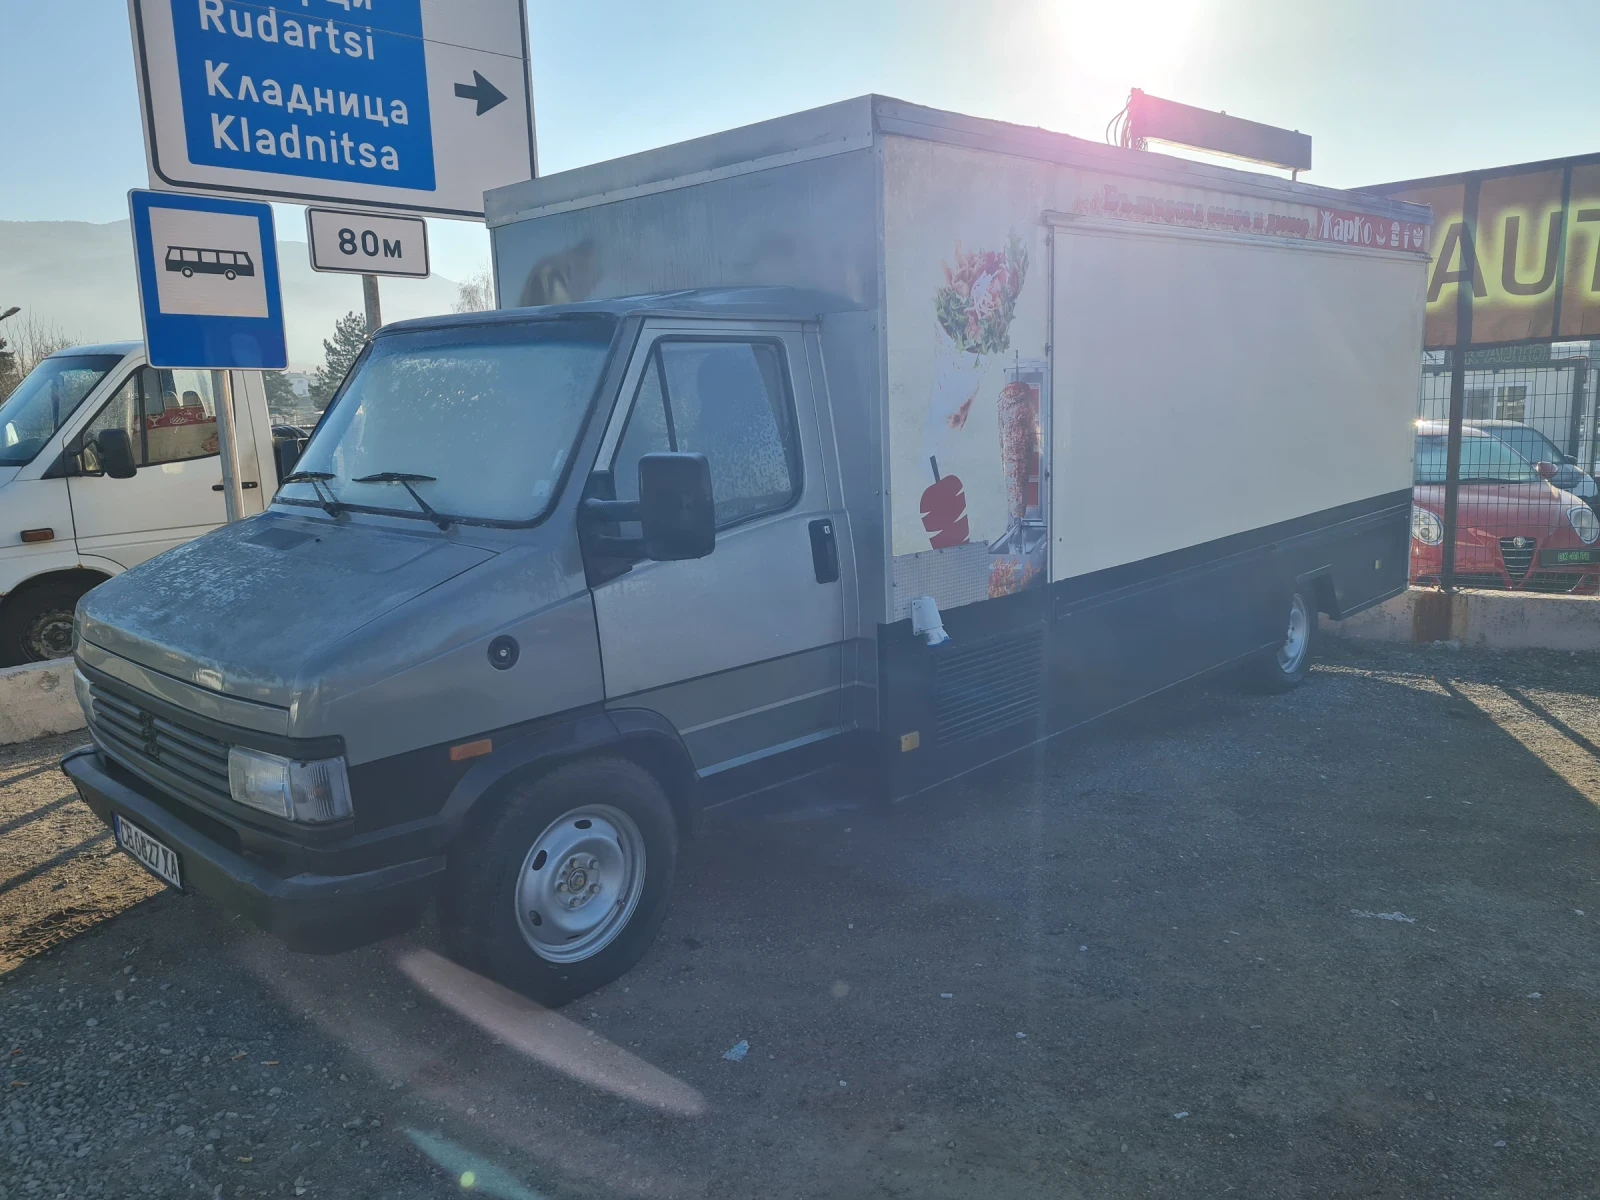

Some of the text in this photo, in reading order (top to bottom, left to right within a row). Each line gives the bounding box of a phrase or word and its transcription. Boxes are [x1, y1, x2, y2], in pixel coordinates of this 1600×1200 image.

[199, 0, 375, 60] Rudartsi
[204, 60, 409, 128] Кладница
[211, 113, 400, 171] Kladnitsa
